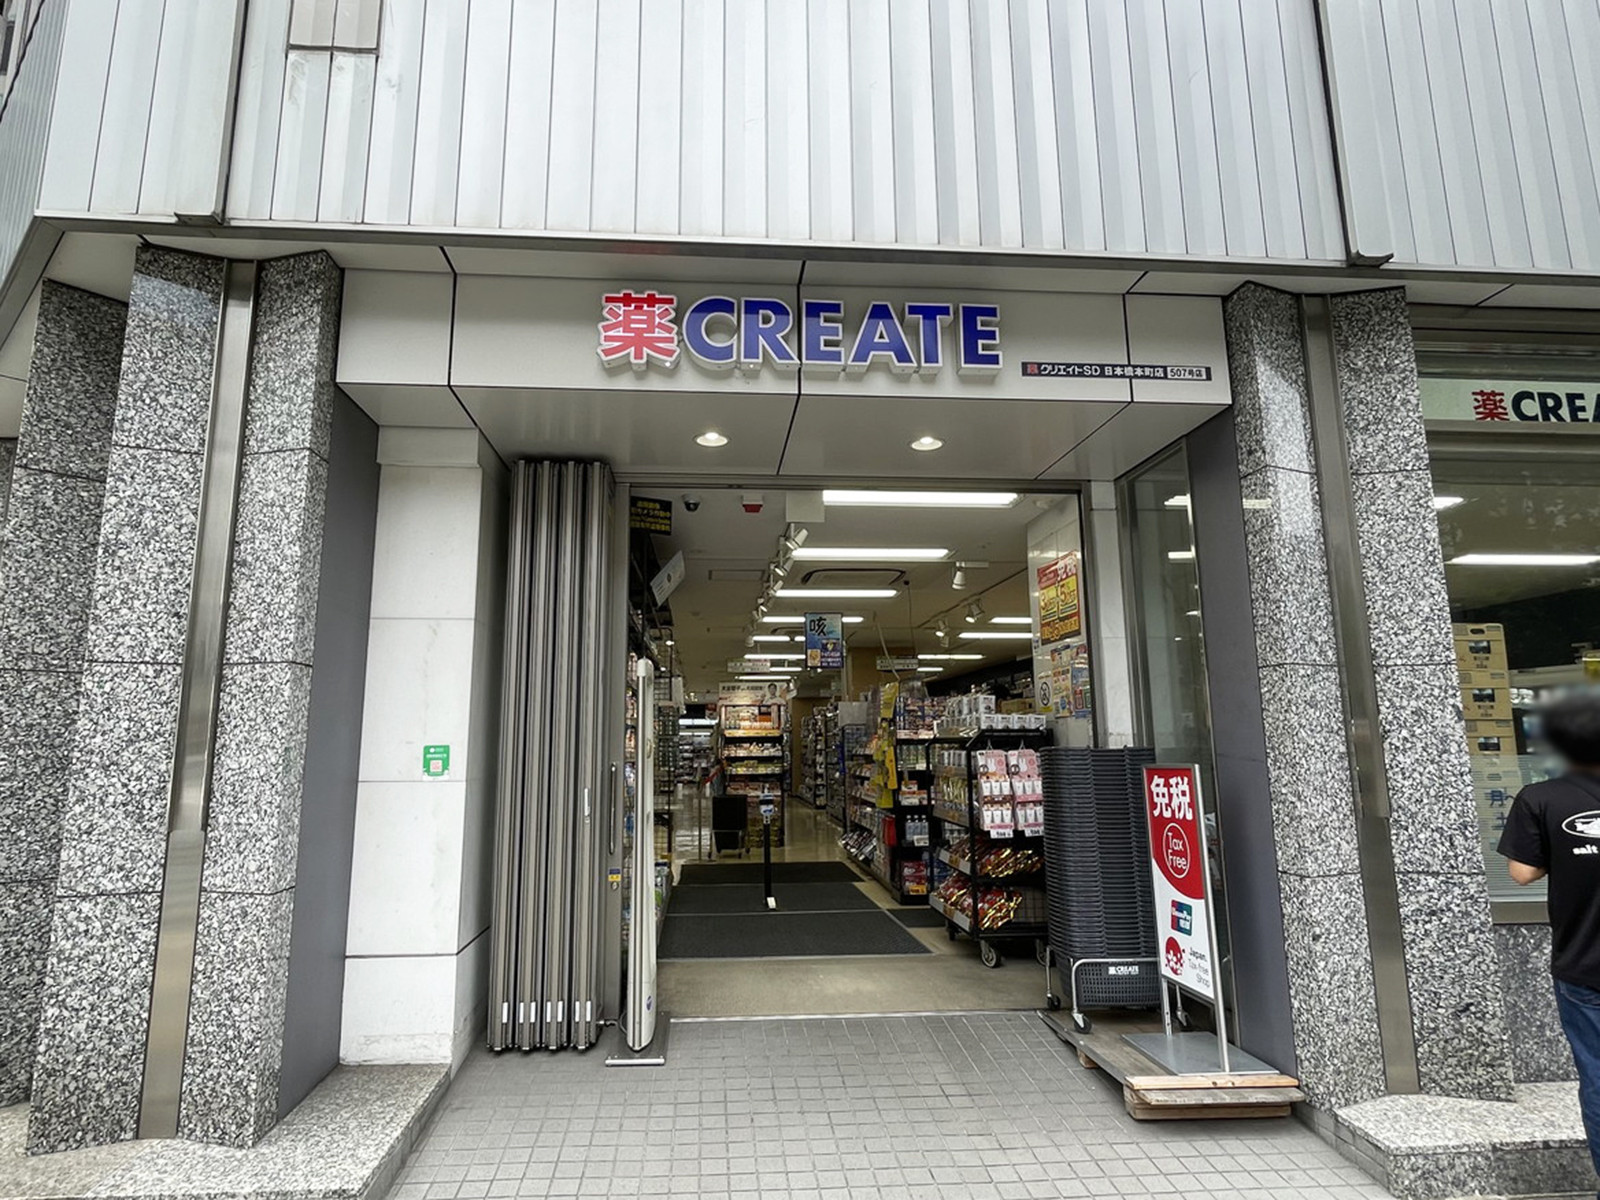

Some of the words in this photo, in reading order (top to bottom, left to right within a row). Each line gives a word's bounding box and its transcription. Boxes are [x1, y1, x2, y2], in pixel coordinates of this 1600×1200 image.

[599, 291, 678, 366] 薬
[683, 295, 1003, 371] CREATE
[1040, 364, 1101, 376] クリエイトSD
[1104, 366, 1164, 377] 日本橋本町店
[1169, 368, 1204, 378] 507号店
[1472, 390, 1510, 421] 薬
[1511, 390, 1600, 422] CRE
[809, 616, 827, 636] 咳
[1150, 774, 1194, 821] 免税
[1166, 831, 1185, 851] Tax
[1167, 848, 1188, 870] Free
